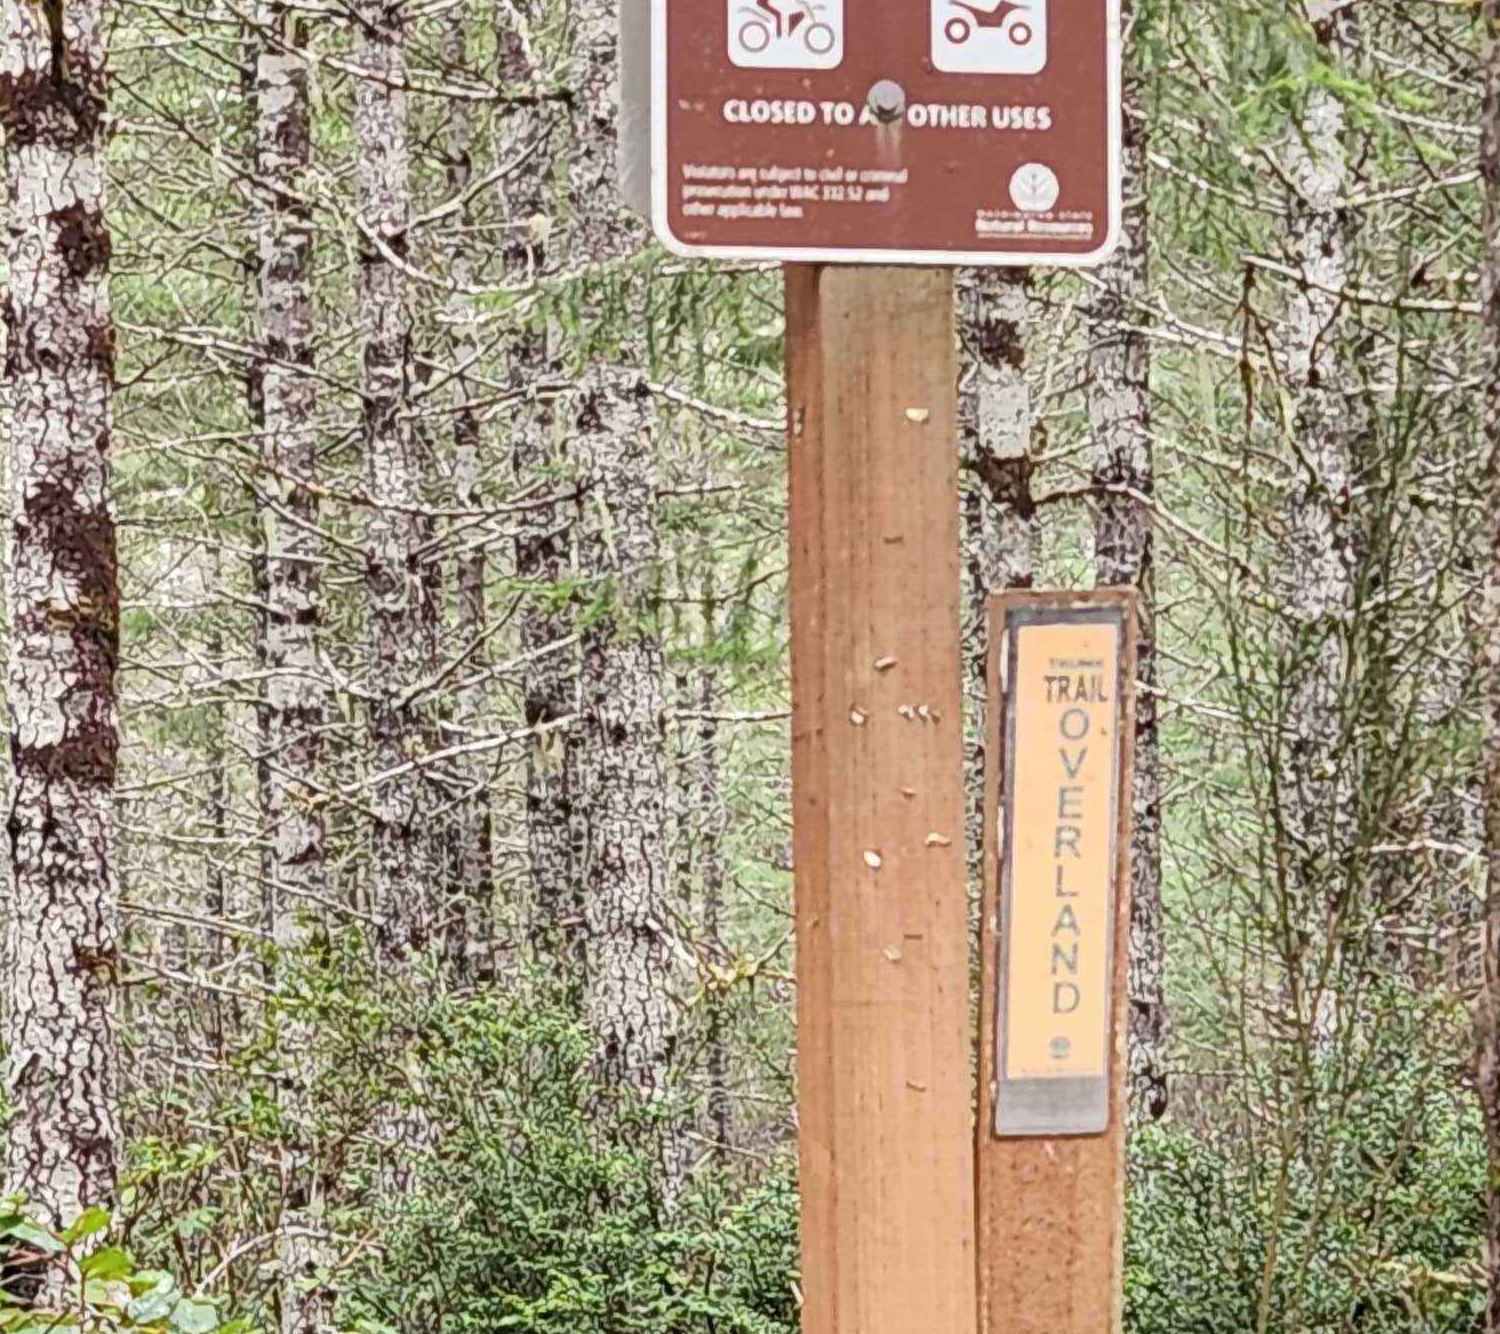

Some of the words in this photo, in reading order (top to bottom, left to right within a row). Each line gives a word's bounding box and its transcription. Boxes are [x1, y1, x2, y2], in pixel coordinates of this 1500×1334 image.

[723, 99, 816, 124] CLOSED
[820, 101, 854, 125] TO
[907, 103, 987, 128] OTHER
[992, 106, 1051, 130] USES
[1044, 675, 1108, 703] TRAIL
[1051, 708, 1090, 1014] OVERLAND
